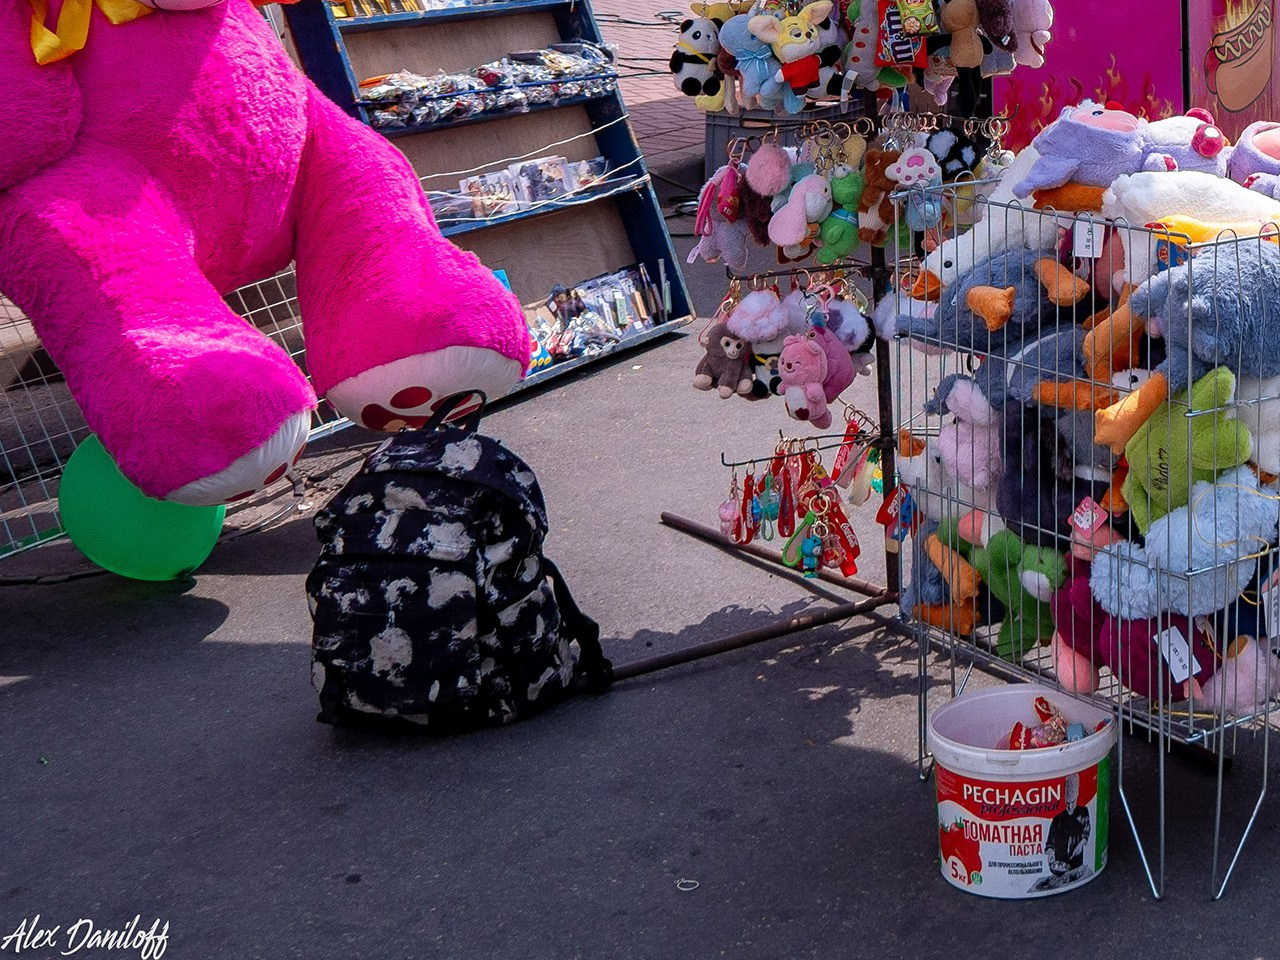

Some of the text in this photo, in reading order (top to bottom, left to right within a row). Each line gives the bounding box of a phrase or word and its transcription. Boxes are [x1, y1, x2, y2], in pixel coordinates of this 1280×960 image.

[963, 783, 1061, 806] PECHAGIN
[980, 802, 1060, 817] professional
[962, 819, 1043, 844] ТОМАТНАЯ
[1009, 843, 1043, 857] ПАСТА
